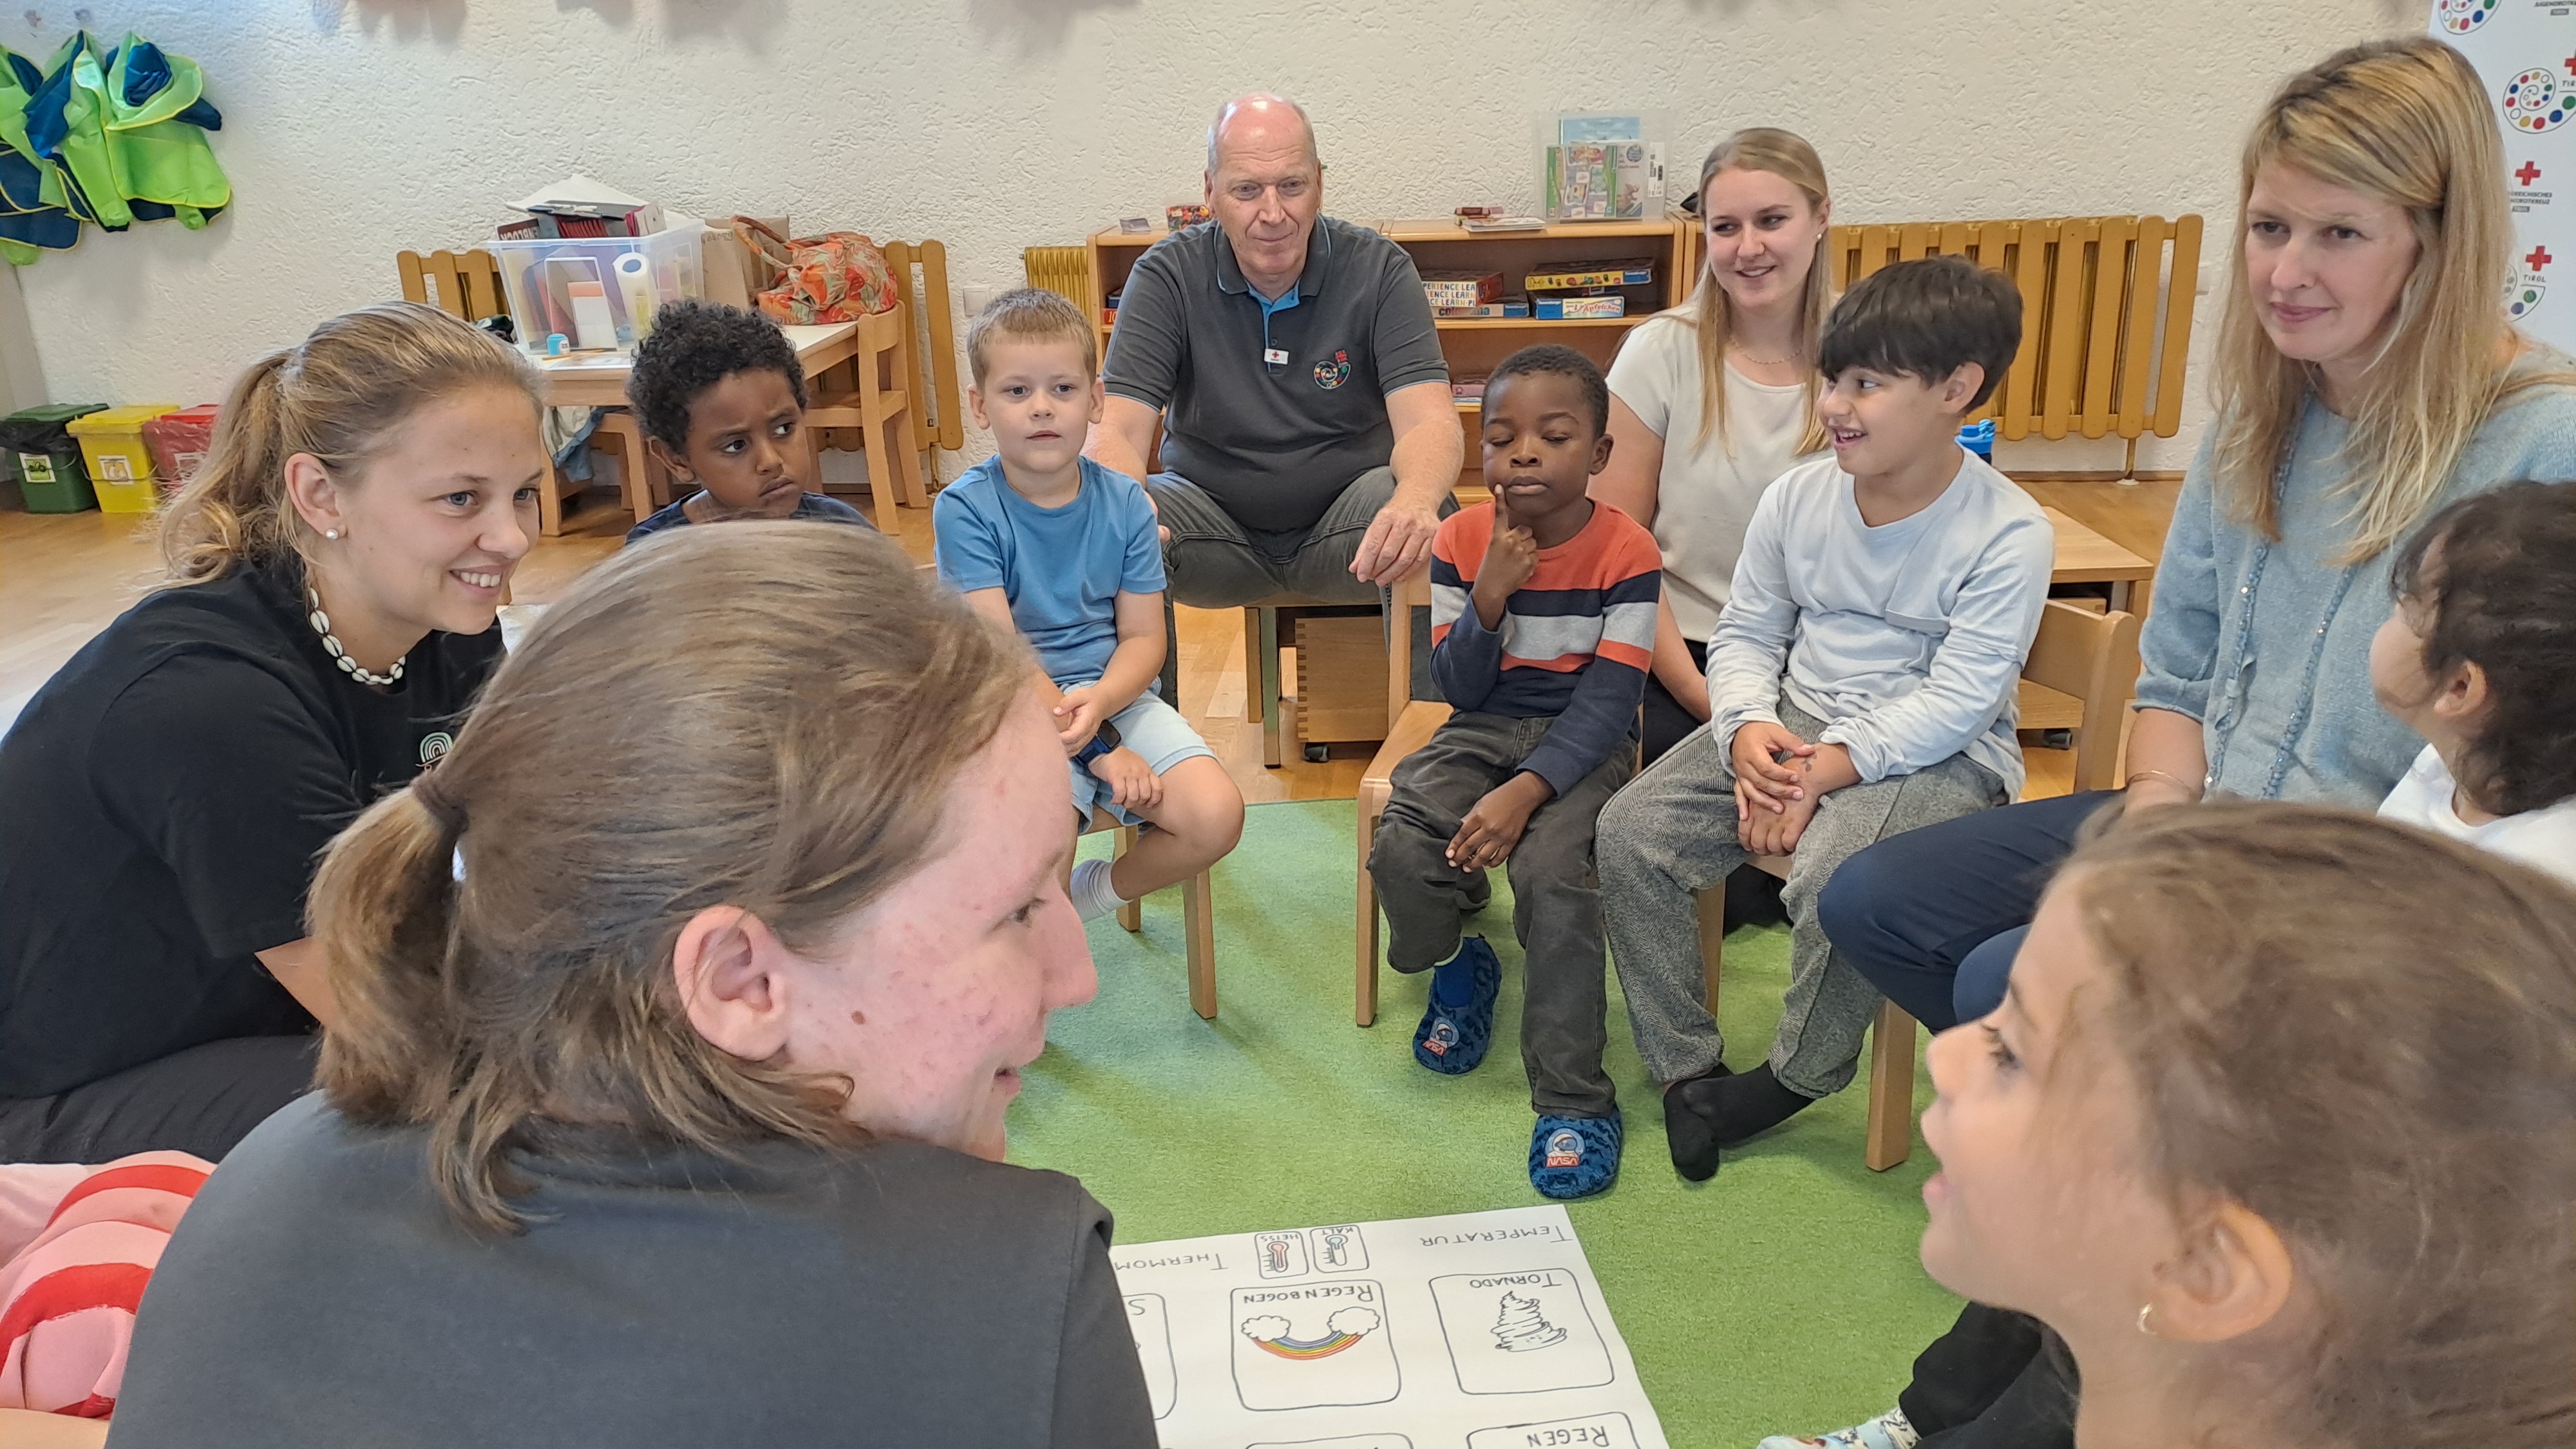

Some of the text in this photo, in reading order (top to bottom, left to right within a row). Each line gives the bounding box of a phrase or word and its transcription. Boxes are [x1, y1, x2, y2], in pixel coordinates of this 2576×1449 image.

[1423, 1041, 1446, 1056] NASA
[1547, 1157, 1578, 1166] NASA
[1321, 1227, 1354, 1235] KALT
[1419, 1226, 1573, 1246] TEMPERATUR
[1470, 1273, 1562, 1289] TORNADO
[1527, 1426, 1610, 1448] REGEN
